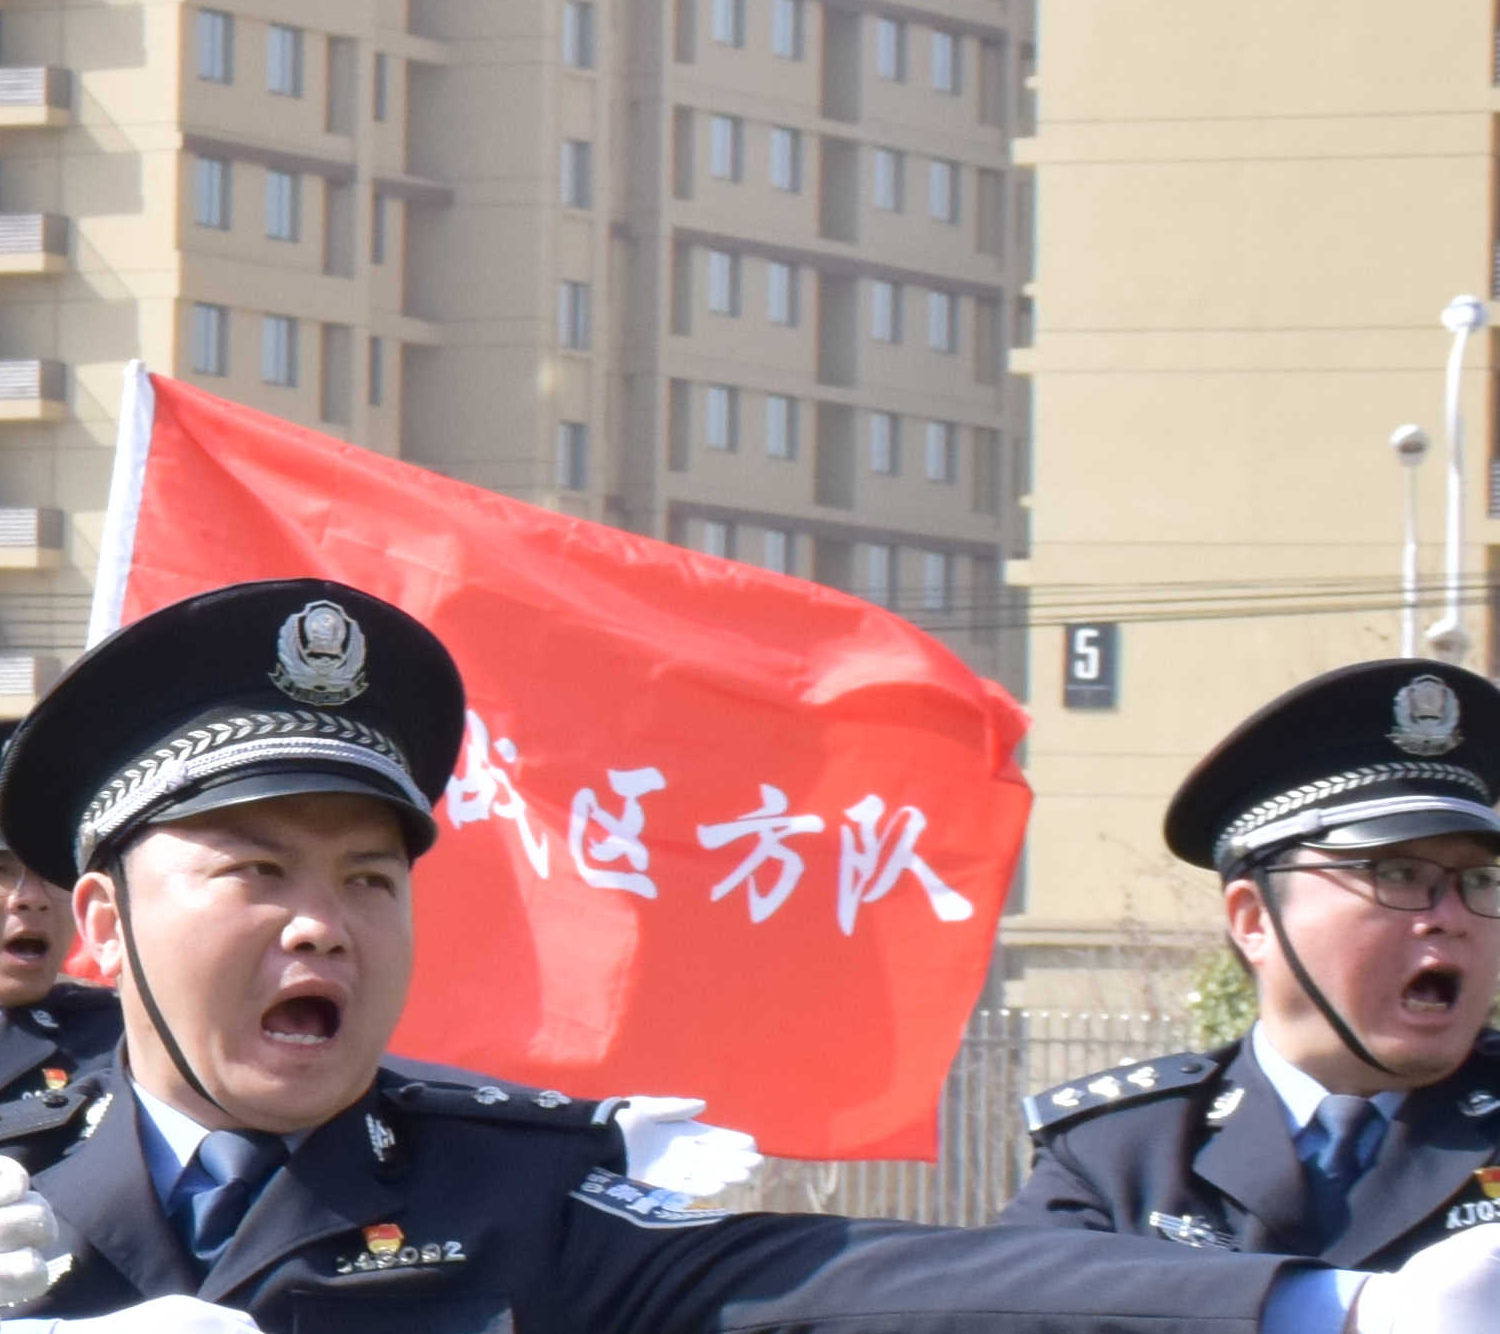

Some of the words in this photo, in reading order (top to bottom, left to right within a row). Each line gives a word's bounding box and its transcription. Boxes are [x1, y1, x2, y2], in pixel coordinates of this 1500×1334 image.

[1073, 628, 1100, 679] 5
[445, 709, 974, 936] 战区方队
